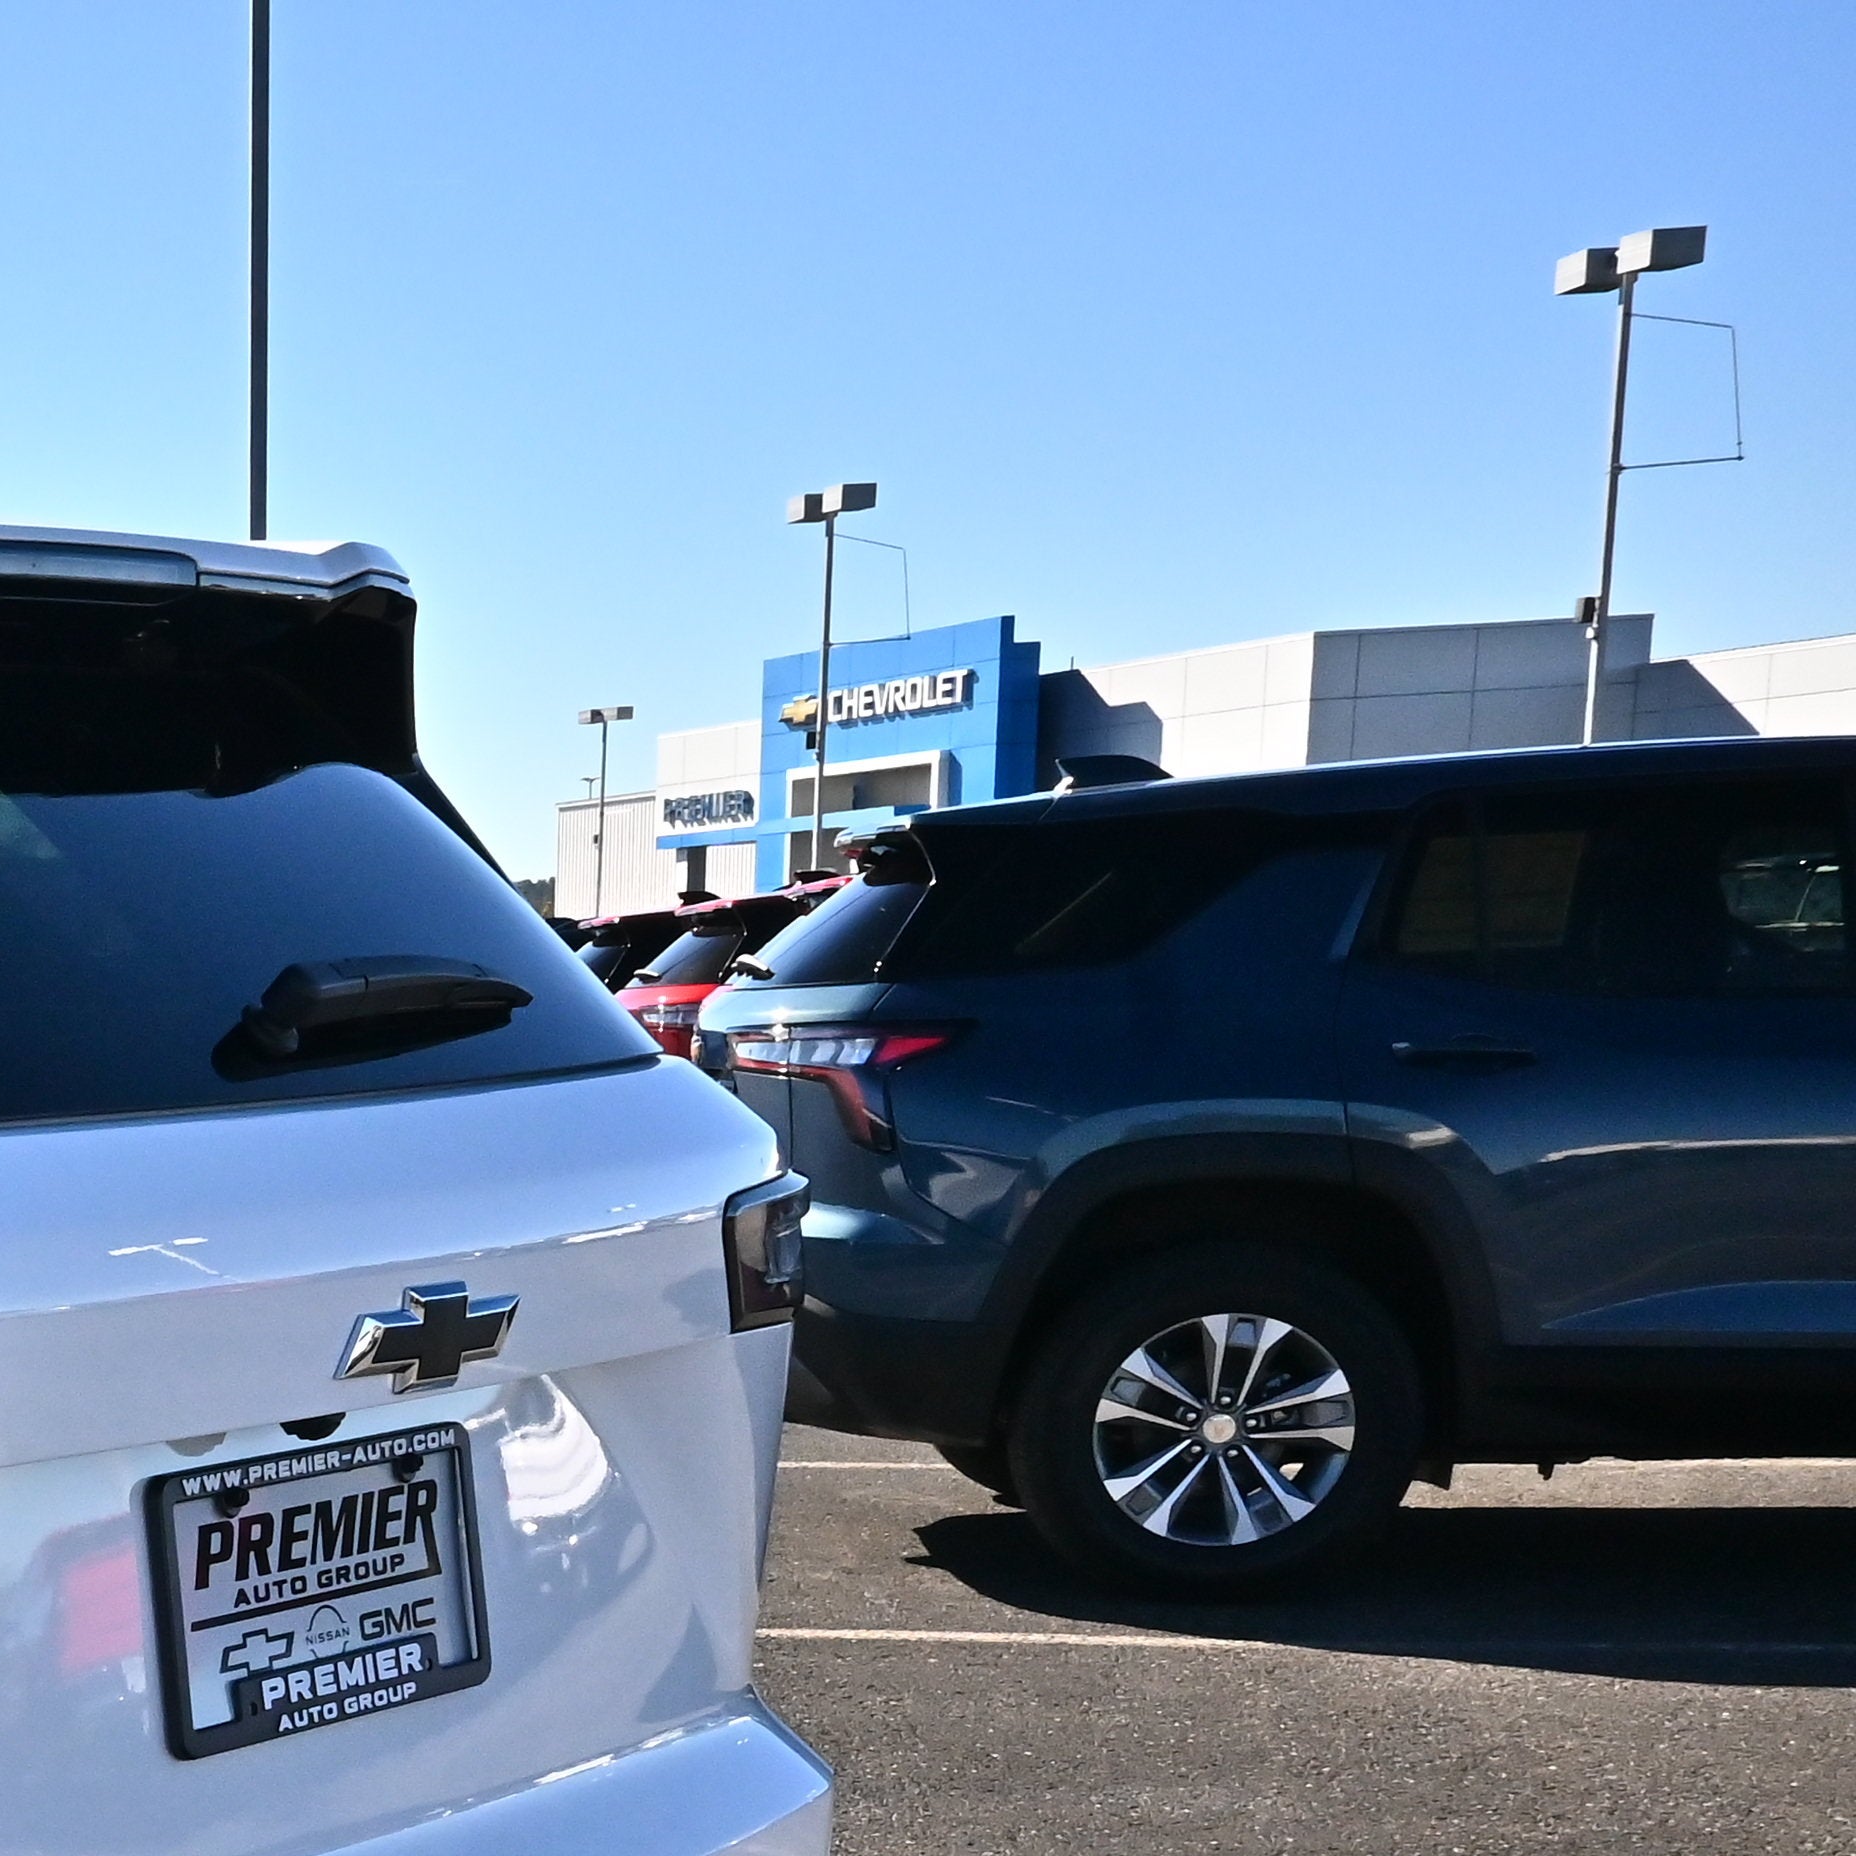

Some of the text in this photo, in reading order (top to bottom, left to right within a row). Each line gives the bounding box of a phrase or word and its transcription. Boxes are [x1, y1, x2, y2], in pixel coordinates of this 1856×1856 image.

[827, 669, 969, 723] CHEVROLET
[664, 789, 748, 825] PREMIER
[180, 1428, 457, 1497] WWW.PREMIER-AUTO.COM
[194, 1478, 442, 1591] PREMIER
[233, 1552, 406, 1609] AUTO GROUP
[305, 1597, 437, 1647] NISSAN GMC
[261, 1642, 424, 1711] PREMIER
[278, 1681, 418, 1733] AUTO GROUP
